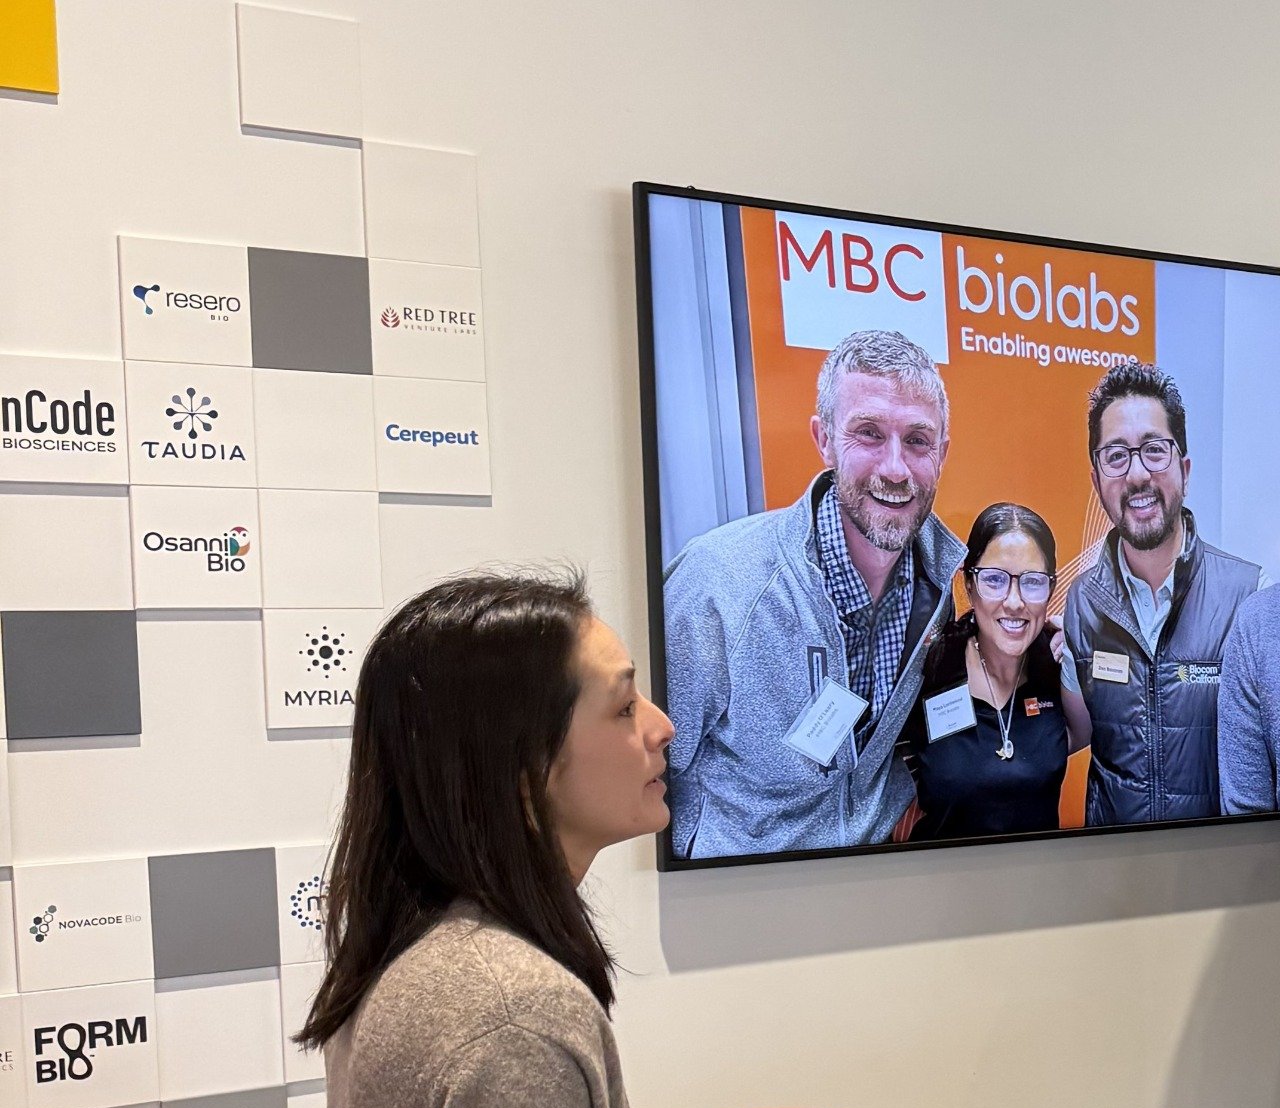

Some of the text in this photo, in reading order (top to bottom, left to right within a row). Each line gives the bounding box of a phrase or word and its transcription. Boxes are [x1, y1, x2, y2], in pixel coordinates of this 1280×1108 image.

[778, 220, 1141, 336] MBC biolabs
[165, 287, 241, 313] resero
[210, 314, 230, 322] BIO
[403, 307, 477, 326] RED TREE
[403, 324, 448, 333] VENTURE
[961, 326, 1139, 368] Enabling awesome
[2, 438, 117, 453] BIOSCIENCES
[385, 424, 480, 448] Cerepeut
[143, 531, 229, 552] Osanni
[207, 552, 246, 573] Bio
[1189, 665, 1218, 674] Biocom
[58, 914, 142, 929] NOVACODE Bio
[34, 1016, 148, 1055] FORM
[36, 1052, 94, 1084] BIO
